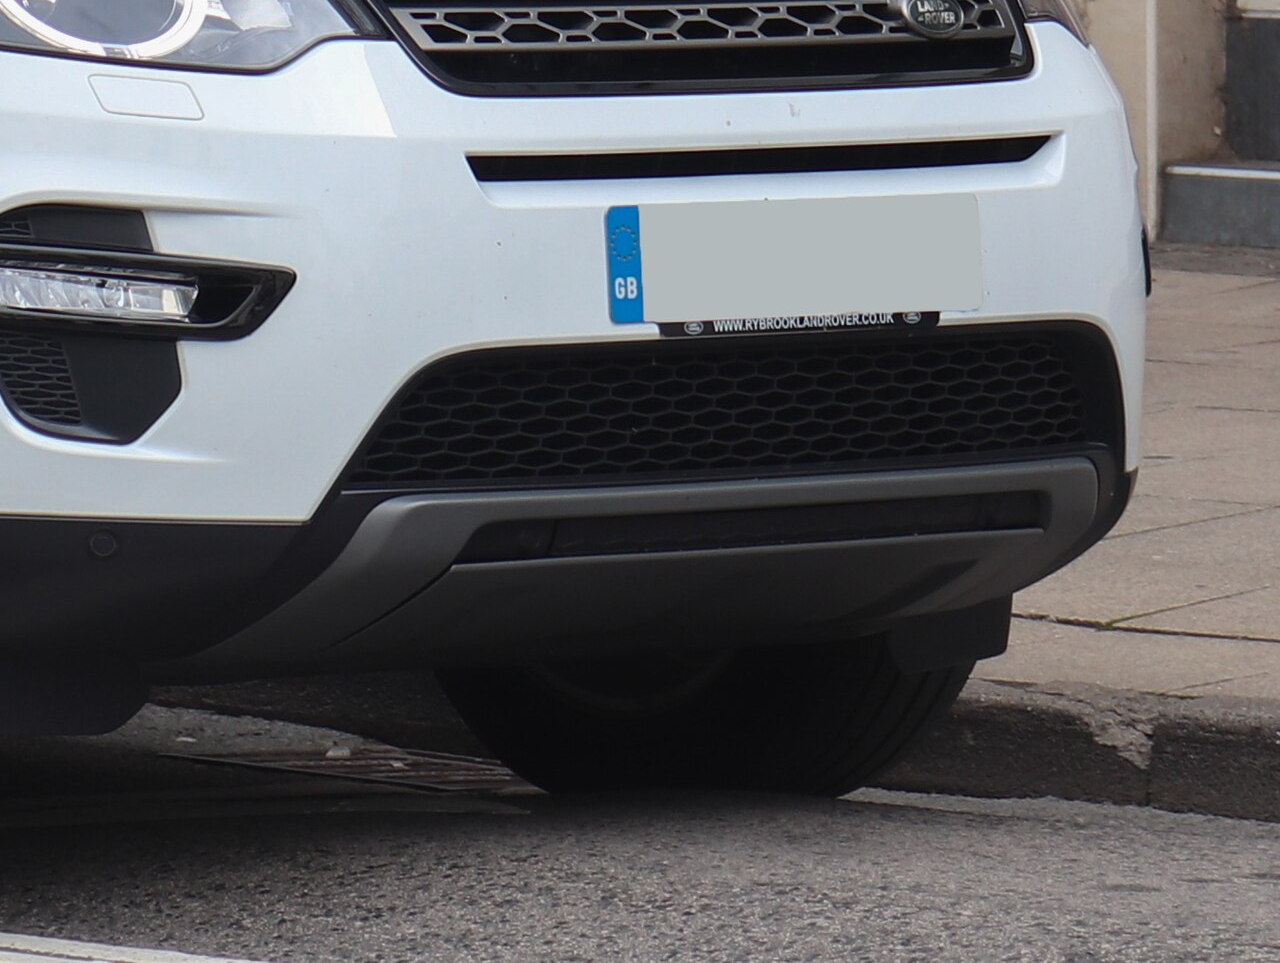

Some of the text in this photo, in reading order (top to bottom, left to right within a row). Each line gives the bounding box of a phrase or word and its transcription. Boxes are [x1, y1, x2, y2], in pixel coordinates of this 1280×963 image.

[916, 0, 944, 13] LAND
[924, 11, 956, 25] ROVER
[614, 276, 638, 300] GB
[712, 312, 895, 333] WWW.RYBROOKLANDROVER.CO.UK
